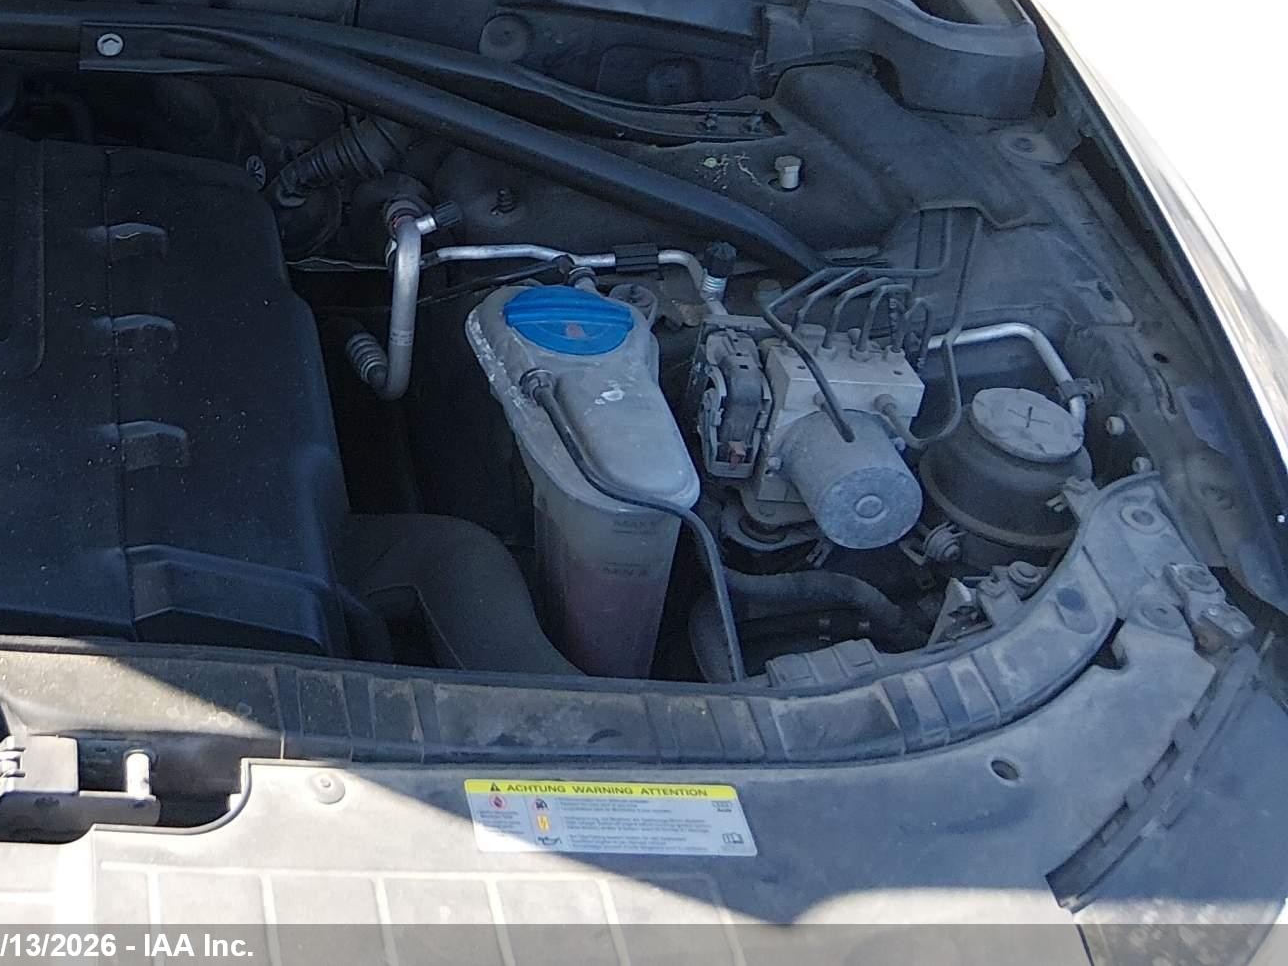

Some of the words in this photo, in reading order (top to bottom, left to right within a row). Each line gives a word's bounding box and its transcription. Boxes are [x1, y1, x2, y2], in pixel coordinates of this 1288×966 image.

[507, 784, 567, 793] ACHTUNG
[572, 786, 634, 795] WARNING
[640, 788, 708, 797] ATTENTION
